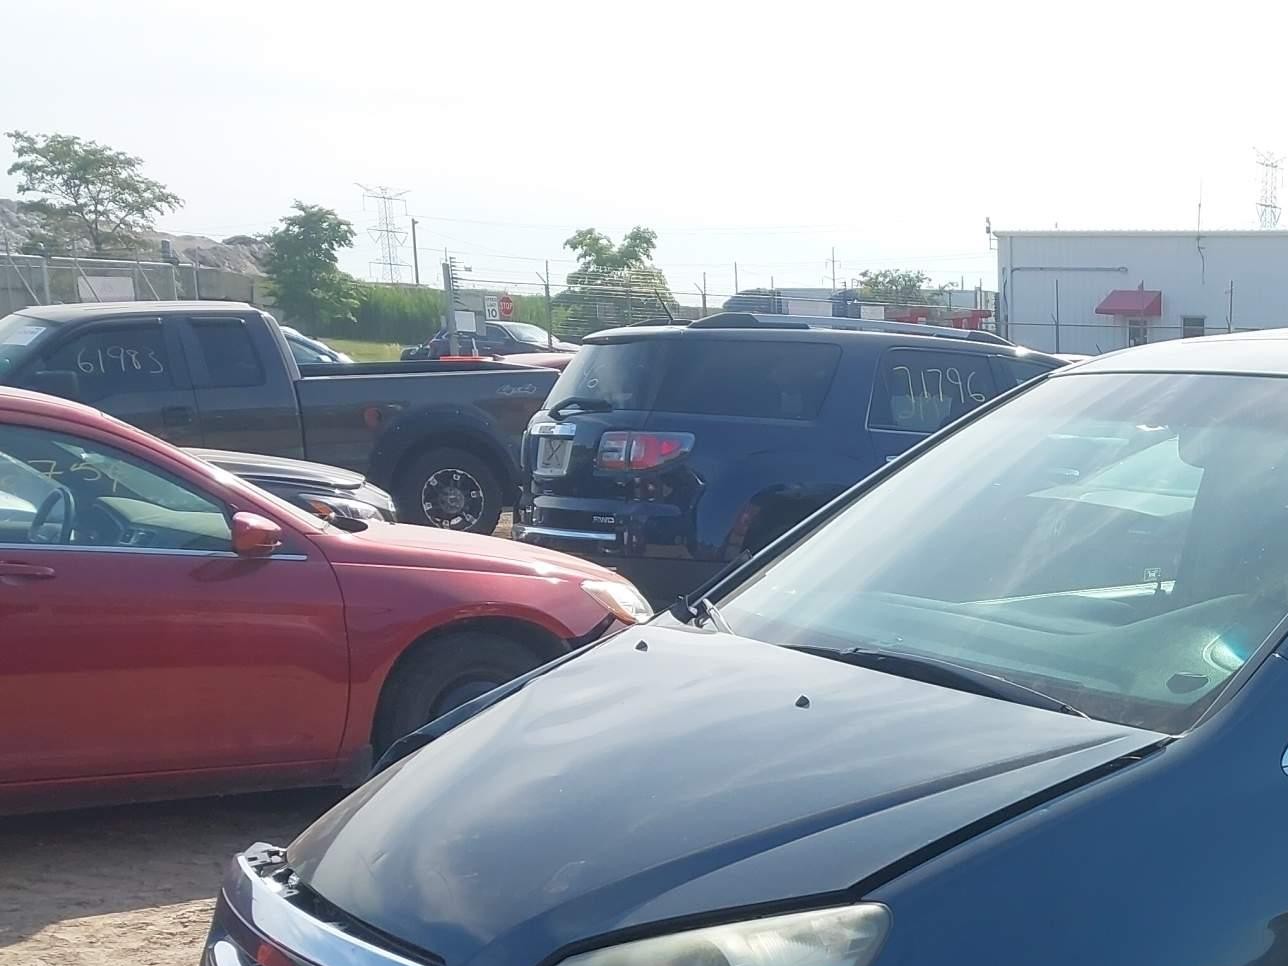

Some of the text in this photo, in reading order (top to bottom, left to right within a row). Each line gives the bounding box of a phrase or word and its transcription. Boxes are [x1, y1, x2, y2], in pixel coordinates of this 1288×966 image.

[500, 301, 512, 310] STOP
[487, 308, 497, 318] 10
[893, 366, 985, 403] 71796
